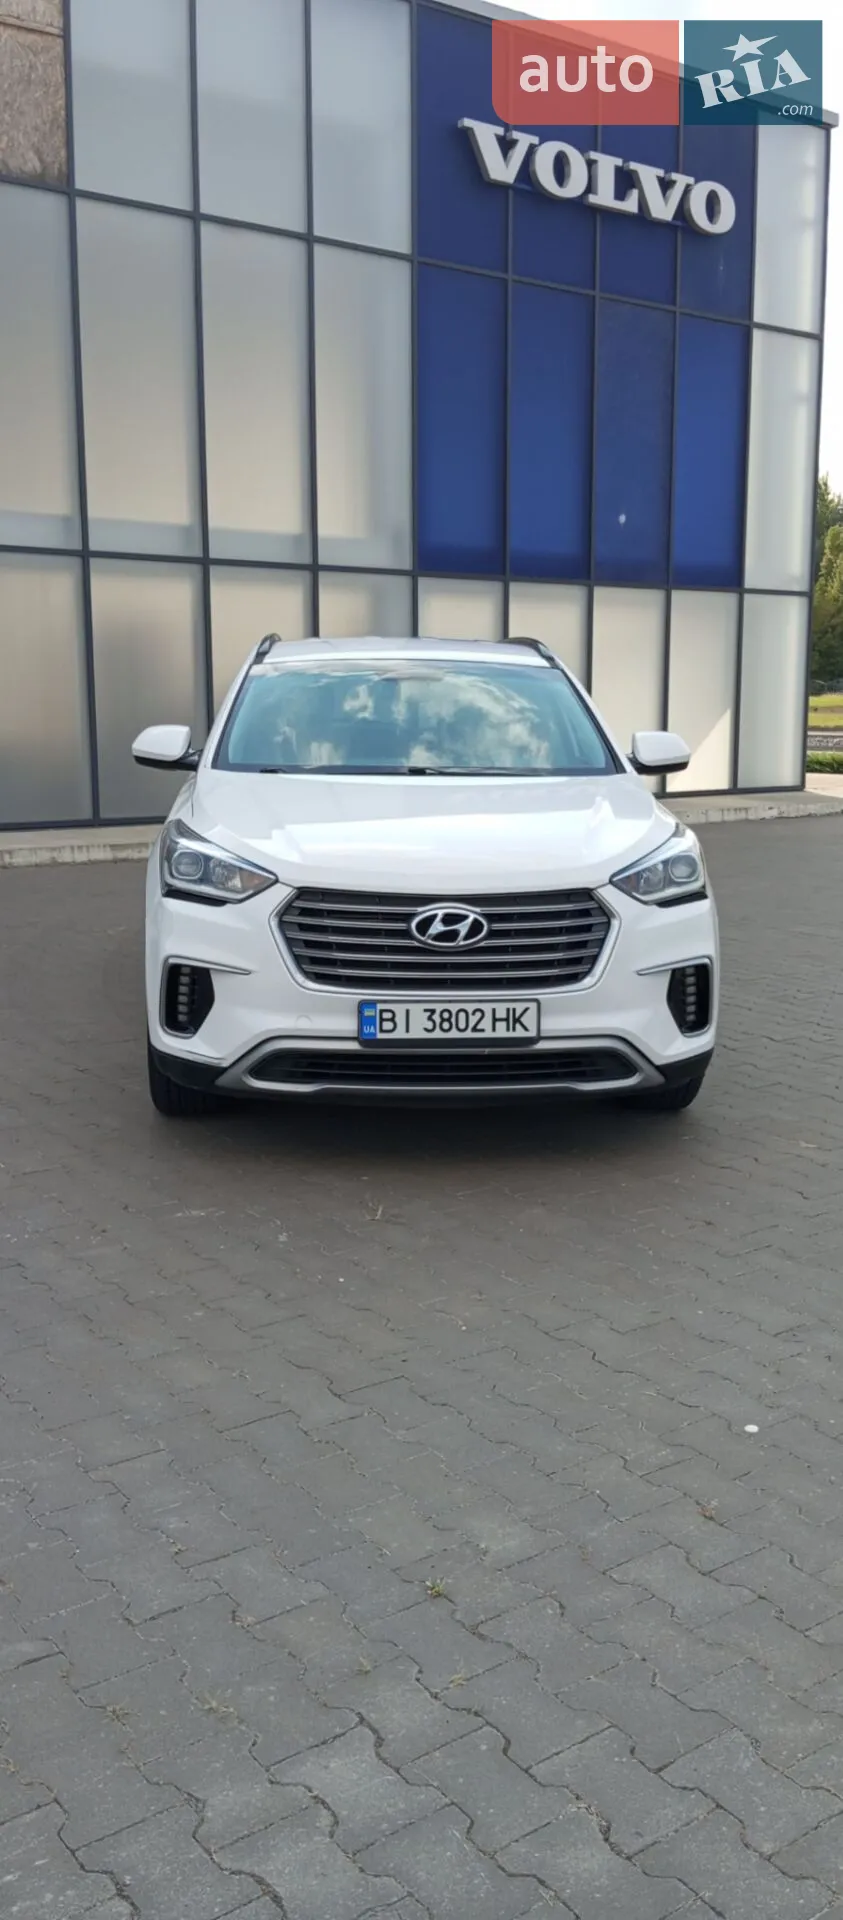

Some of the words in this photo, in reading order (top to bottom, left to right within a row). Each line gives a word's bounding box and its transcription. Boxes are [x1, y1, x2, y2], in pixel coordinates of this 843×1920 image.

[458, 117, 736, 236] VOLVO
[363, 1025, 376, 1033] UA
[423, 1008, 486, 1033] 3802
[491, 1007, 530, 1032] HK
